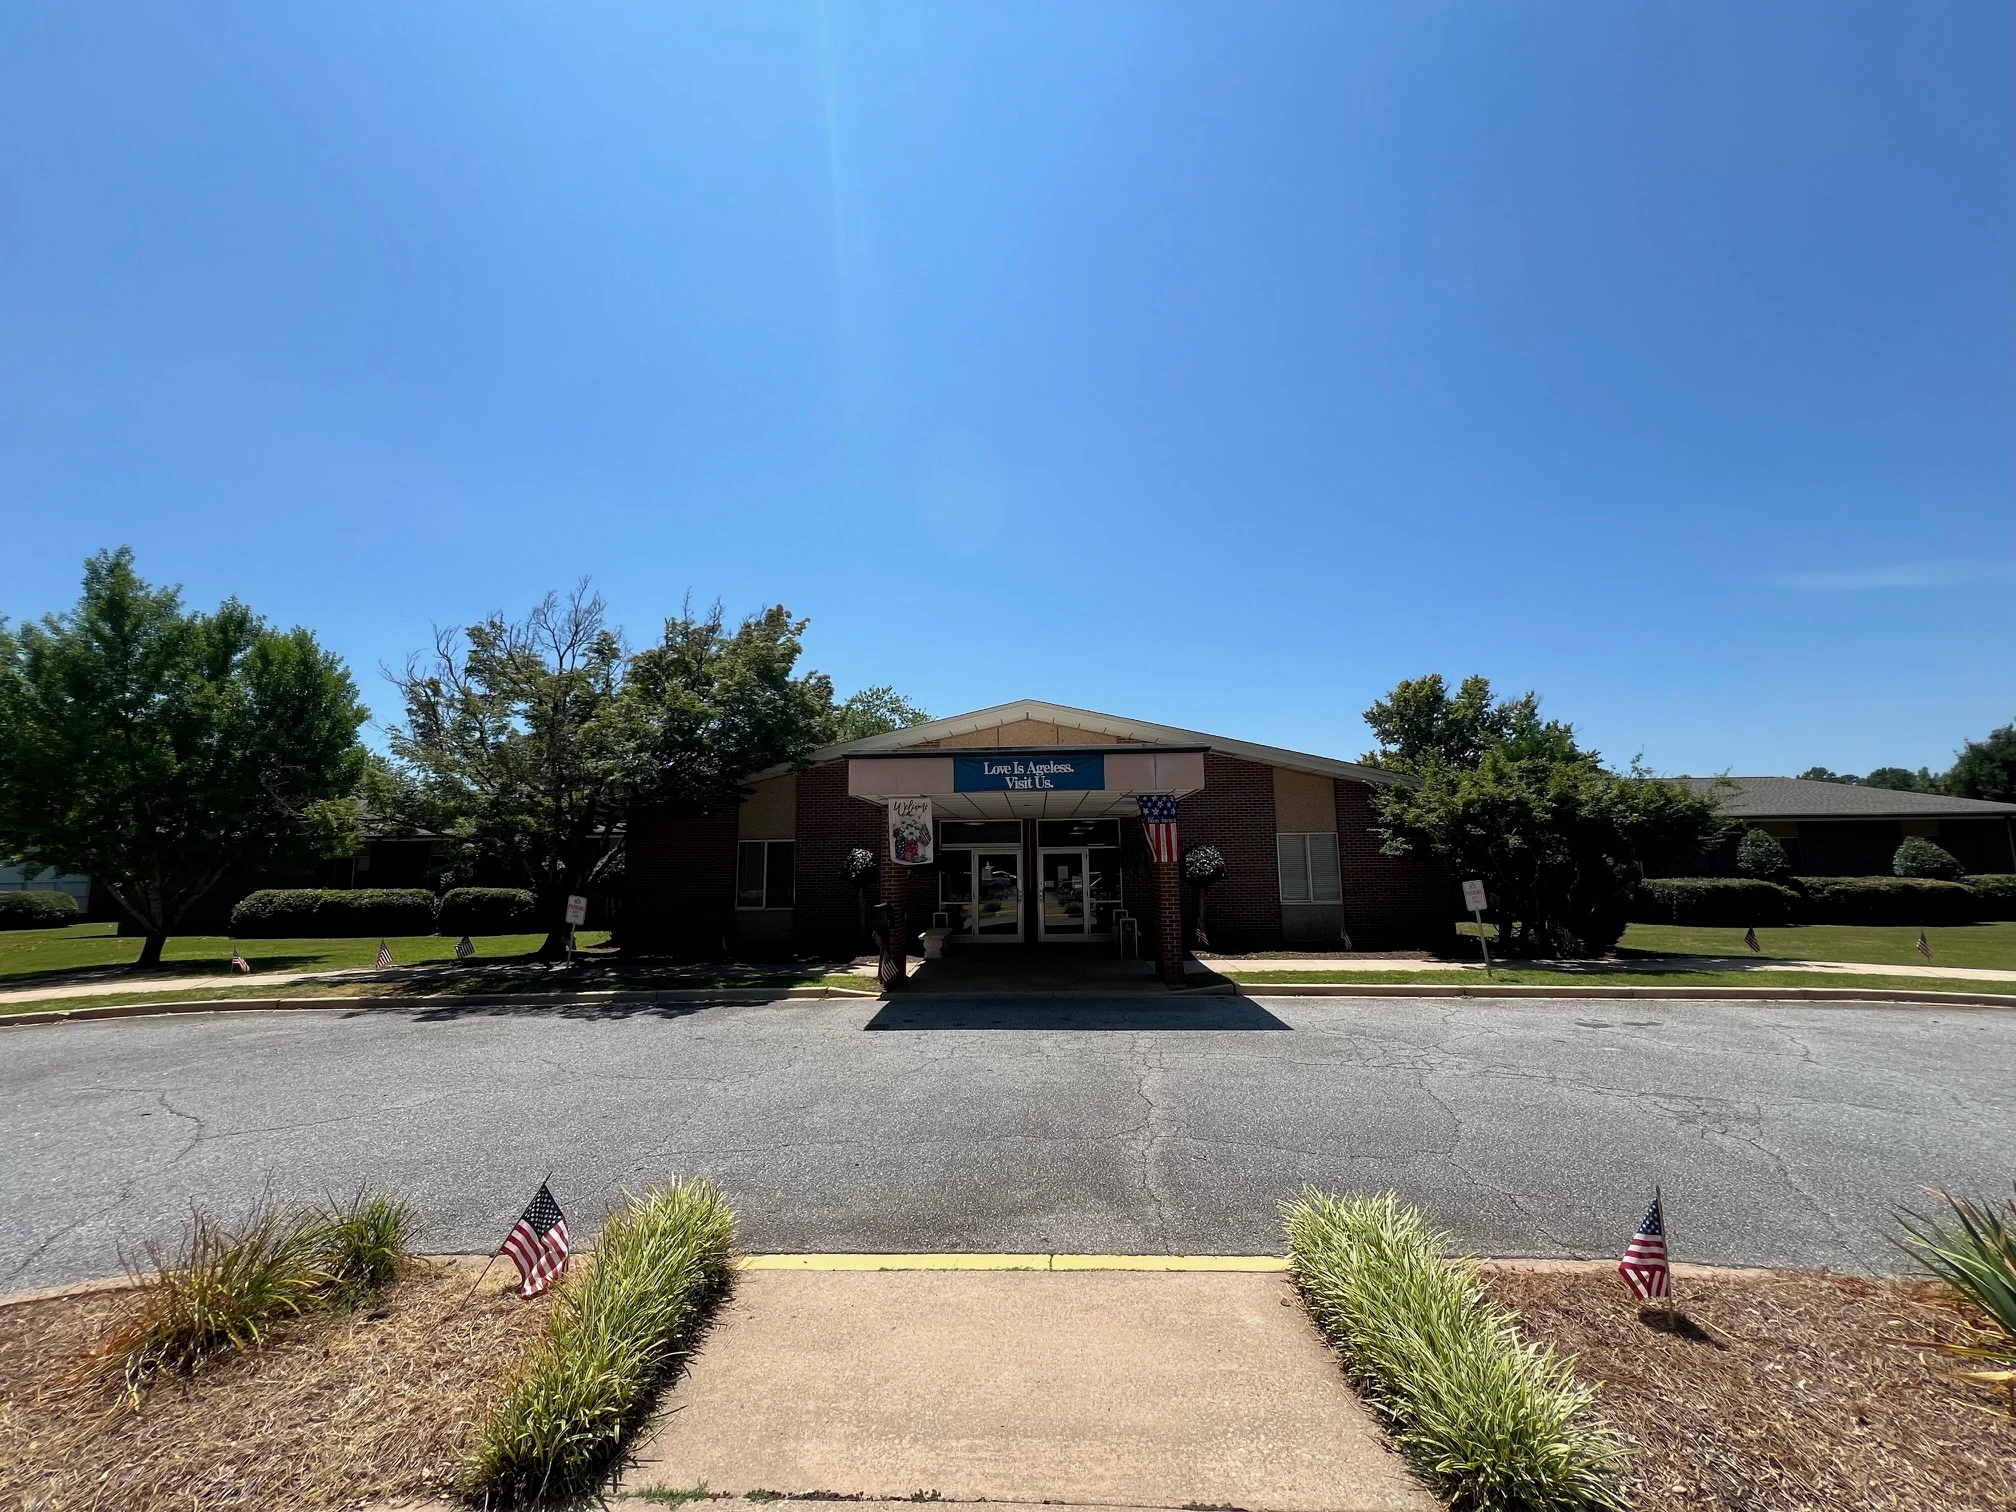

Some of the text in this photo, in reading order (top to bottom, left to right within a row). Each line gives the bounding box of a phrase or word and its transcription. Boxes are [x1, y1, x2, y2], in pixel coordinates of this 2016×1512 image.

[983, 760, 1074, 776] Love Is Ageless.
[1005, 776, 1054, 789] Visit Us.
